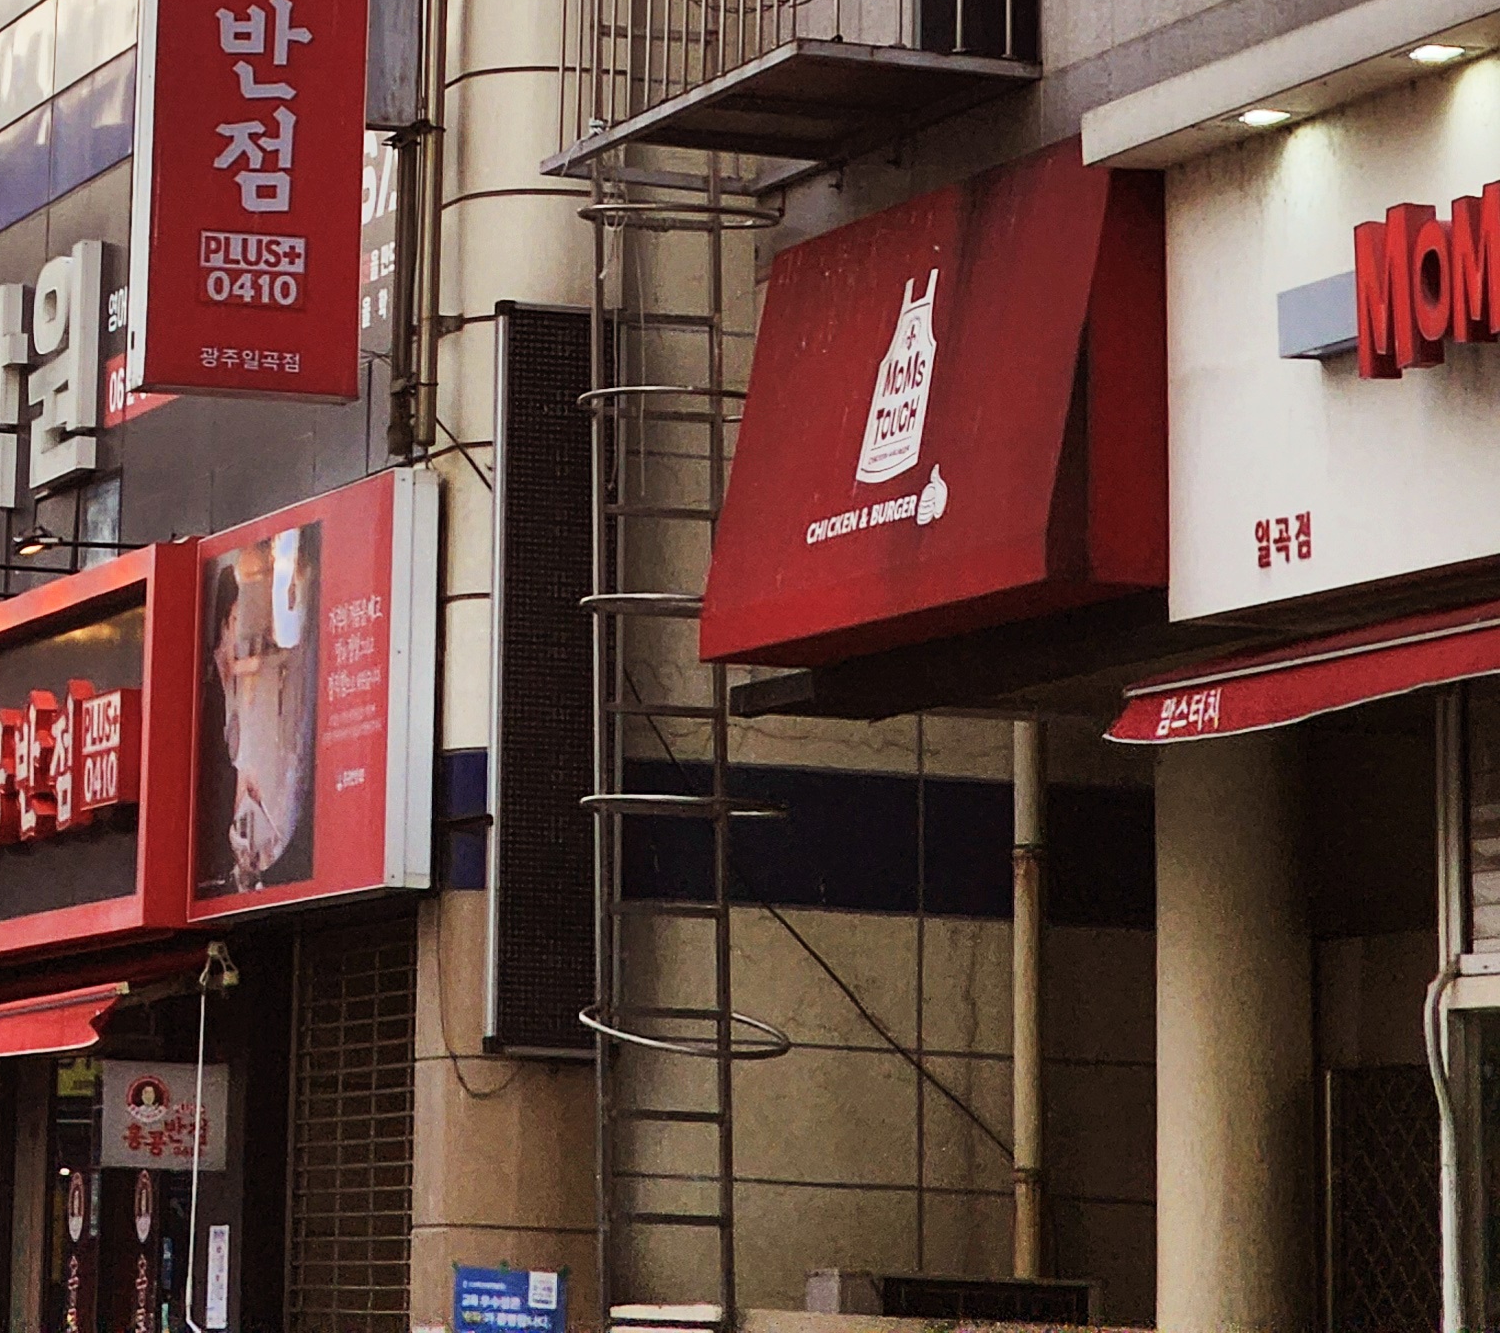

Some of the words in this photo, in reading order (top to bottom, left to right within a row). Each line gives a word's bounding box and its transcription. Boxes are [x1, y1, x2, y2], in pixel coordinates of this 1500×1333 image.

[206, 270, 298, 306] 0410
[199, 345, 301, 374] 광주일곡점
[806, 510, 858, 545] CHICKEN
[859, 505, 869, 528] &
[869, 494, 918, 526] BURGER
[1253, 510, 1312, 569] 일곡점
[1155, 687, 1223, 736] 맘스터치
[83, 750, 118, 803] 0410
